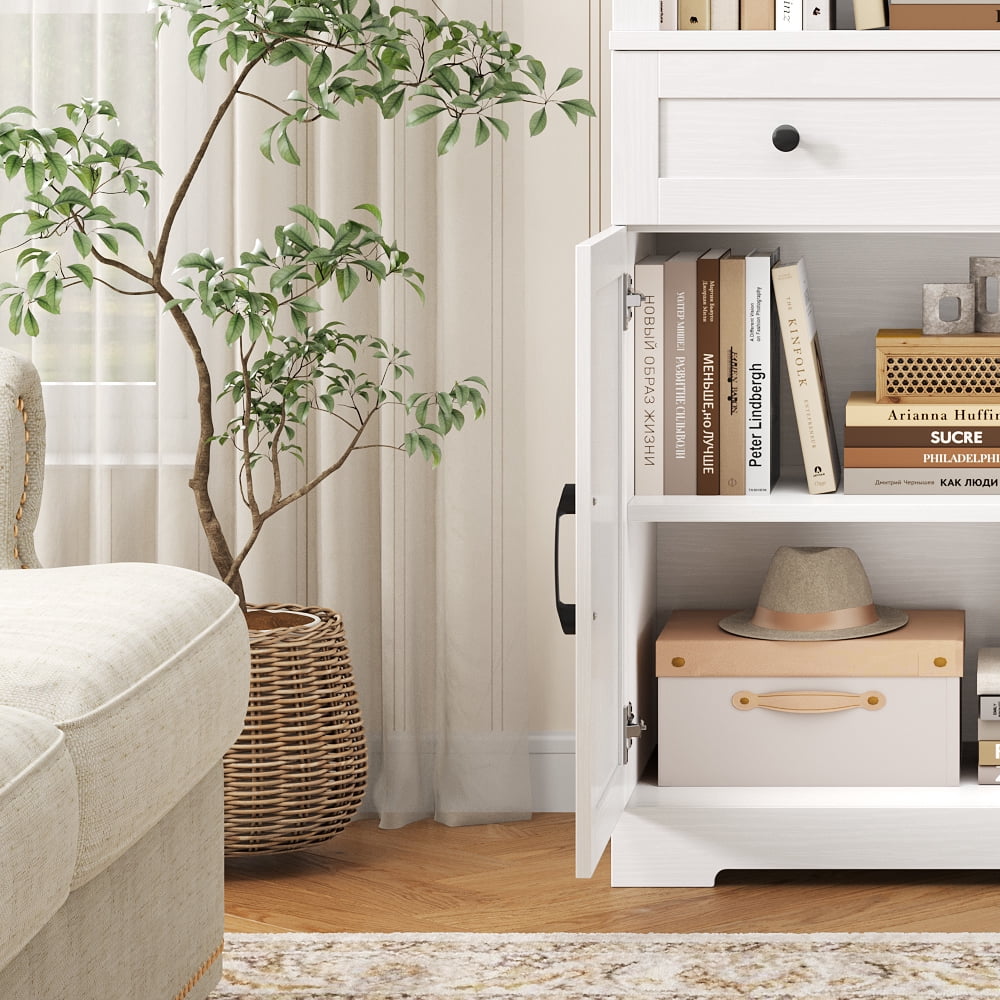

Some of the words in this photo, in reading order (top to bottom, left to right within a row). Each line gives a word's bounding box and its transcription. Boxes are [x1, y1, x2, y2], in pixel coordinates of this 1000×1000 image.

[644, 295, 658, 350] НОВЫЙ
[785, 296, 793, 311] THE
[788, 318, 808, 388] KINFOLK
[644, 356, 656, 405] ОБРАЗ
[675, 356, 686, 405] РАЗВИТИЕ
[748, 363, 766, 430] Lindbergh
[644, 409, 656, 467] ЖИЗНИ
[888, 409, 948, 421] Arianna
[930, 430, 983, 444] SUCRE
[702, 430, 715, 474] ЛУЧШЕ
[748, 432, 762, 468] Peter
[940, 478, 962, 487] КАК
[964, 478, 998, 488] ЛЮДИ
